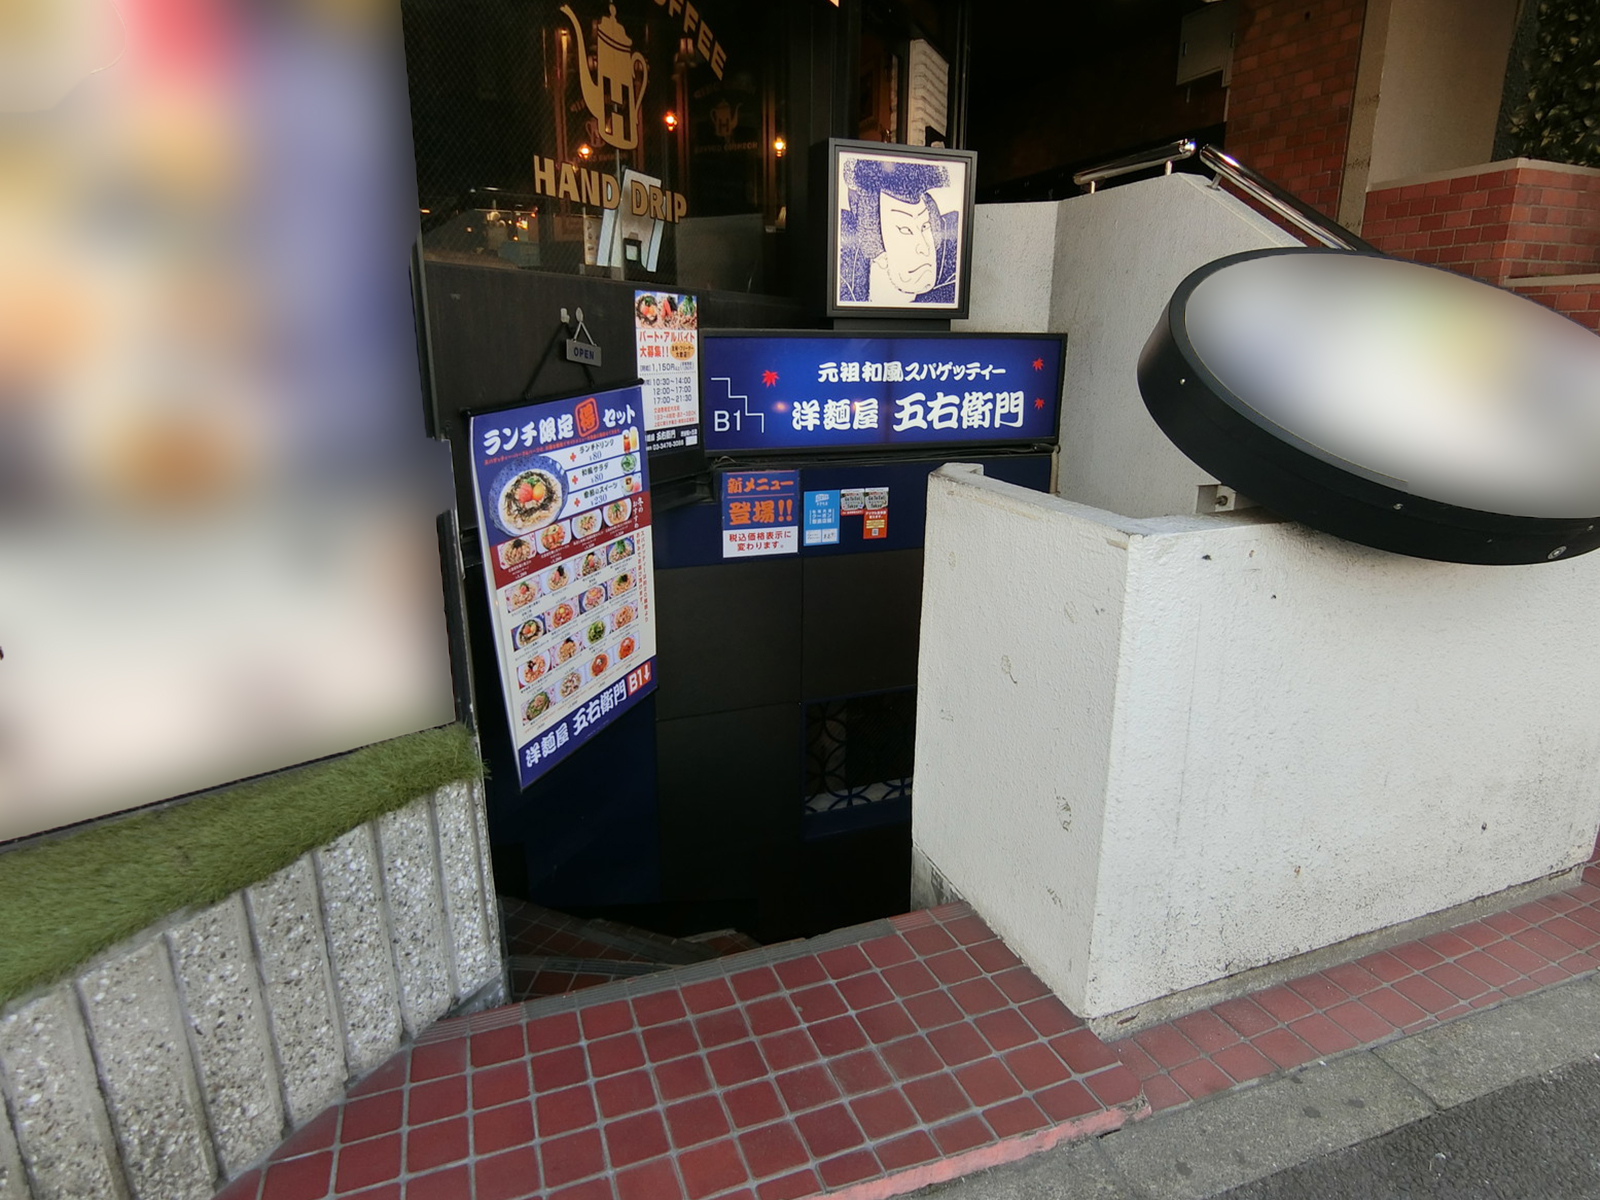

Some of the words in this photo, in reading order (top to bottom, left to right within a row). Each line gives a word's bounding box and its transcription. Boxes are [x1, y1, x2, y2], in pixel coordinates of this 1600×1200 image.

[533, 154, 621, 210] HAND
[630, 179, 688, 224] DRIP
[573, 346, 595, 360] OPEN
[818, 360, 1006, 384] 元祖和風スパゲッティー
[713, 410, 741, 432] B1
[892, 390, 1025, 432] 五右衛門
[483, 413, 574, 456] ランチ限定
[602, 404, 636, 428] セット
[579, 438, 614, 454] ランチドリンク
[727, 477, 794, 494] 新メニュー
[729, 498, 793, 526] 登場!!
[729, 530, 791, 543] 税込価格表示に
[737, 541, 784, 552] 変わります。
[572, 679, 628, 736] 五右衛門
[628, 666, 643, 694] B1
